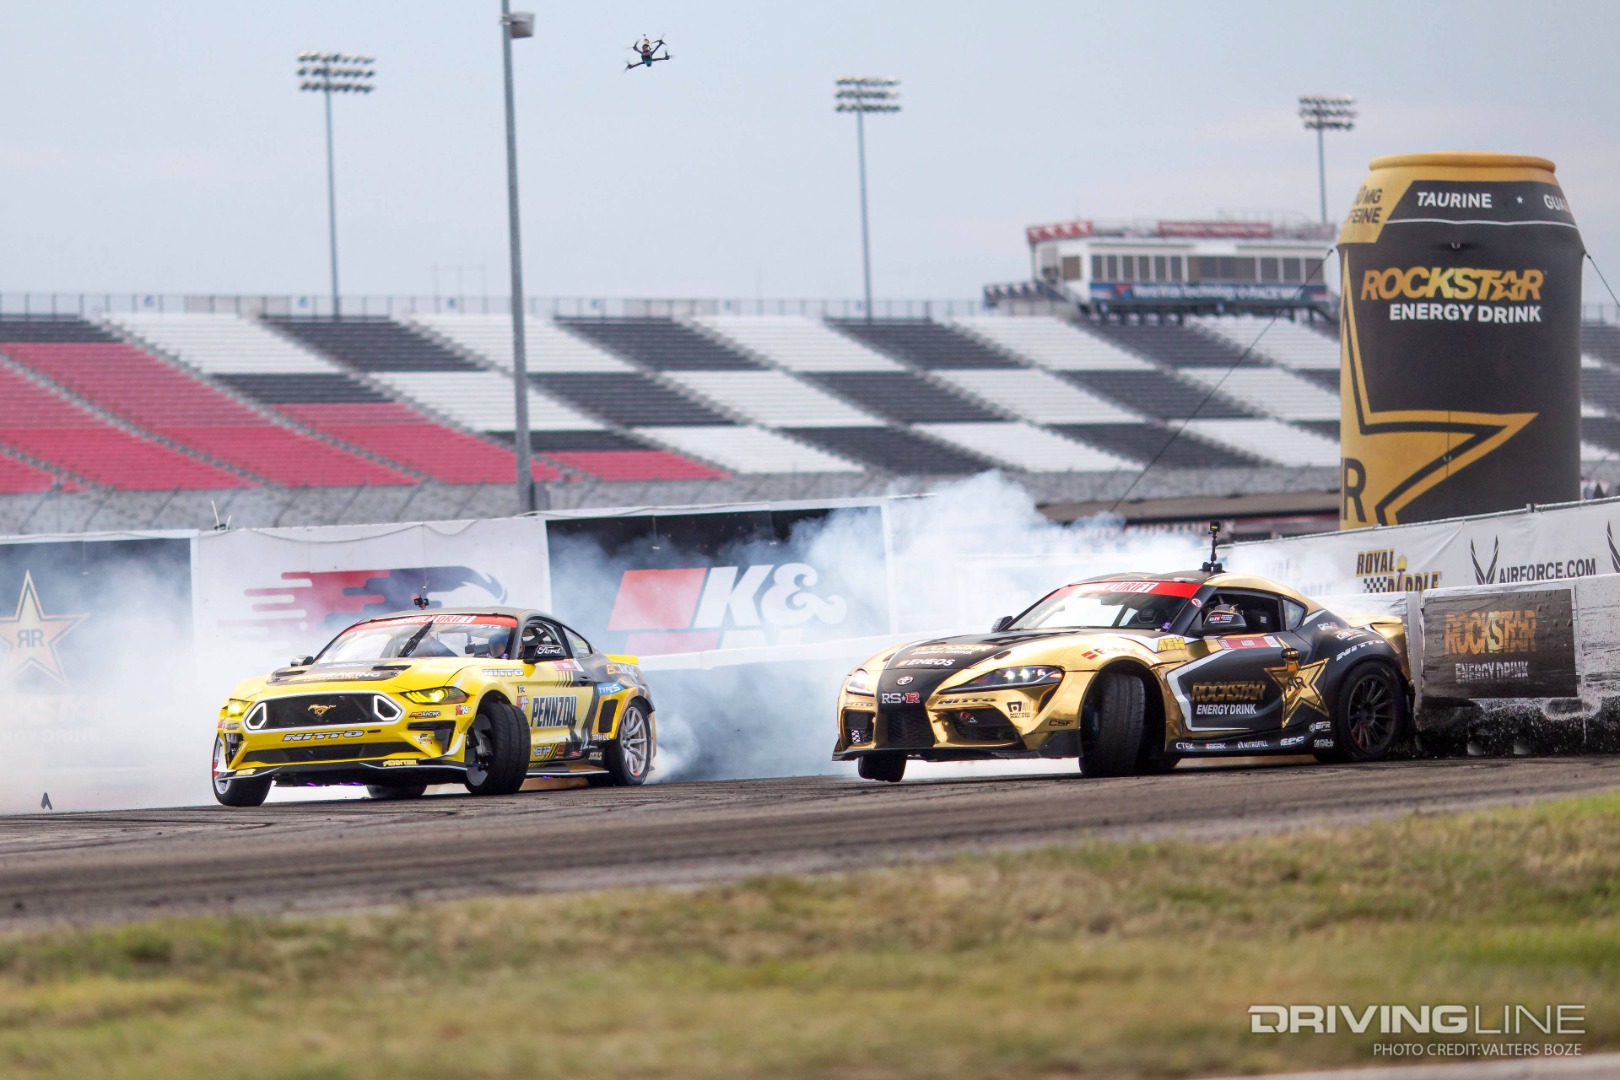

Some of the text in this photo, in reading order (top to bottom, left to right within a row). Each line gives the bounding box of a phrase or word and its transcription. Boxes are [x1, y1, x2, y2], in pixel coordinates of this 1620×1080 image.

[1417, 191, 1493, 209] TAURINE
[1360, 265, 1545, 302] ROCKSTAR
[1389, 302, 1543, 324] ENERGY DRINK
[1356, 549, 1395, 577] ROYAL
[1499, 557, 1597, 583] AIRFORCE.COM
[1113, 581, 1161, 594] DRIFT
[1444, 609, 1538, 656] ROCKSTAR
[536, 645, 562, 655] Ford
[1336, 640, 1385, 662] NITTO
[906, 658, 956, 666] ENEOS
[482, 668, 525, 677] NITTO
[1455, 660, 1529, 685] ENERGY DRINK
[1192, 680, 1267, 701] ROCKSTAR
[938, 697, 997, 705] NITTO
[1196, 703, 1257, 716] ENERGY DRINK
[282, 729, 365, 743] NITTO
